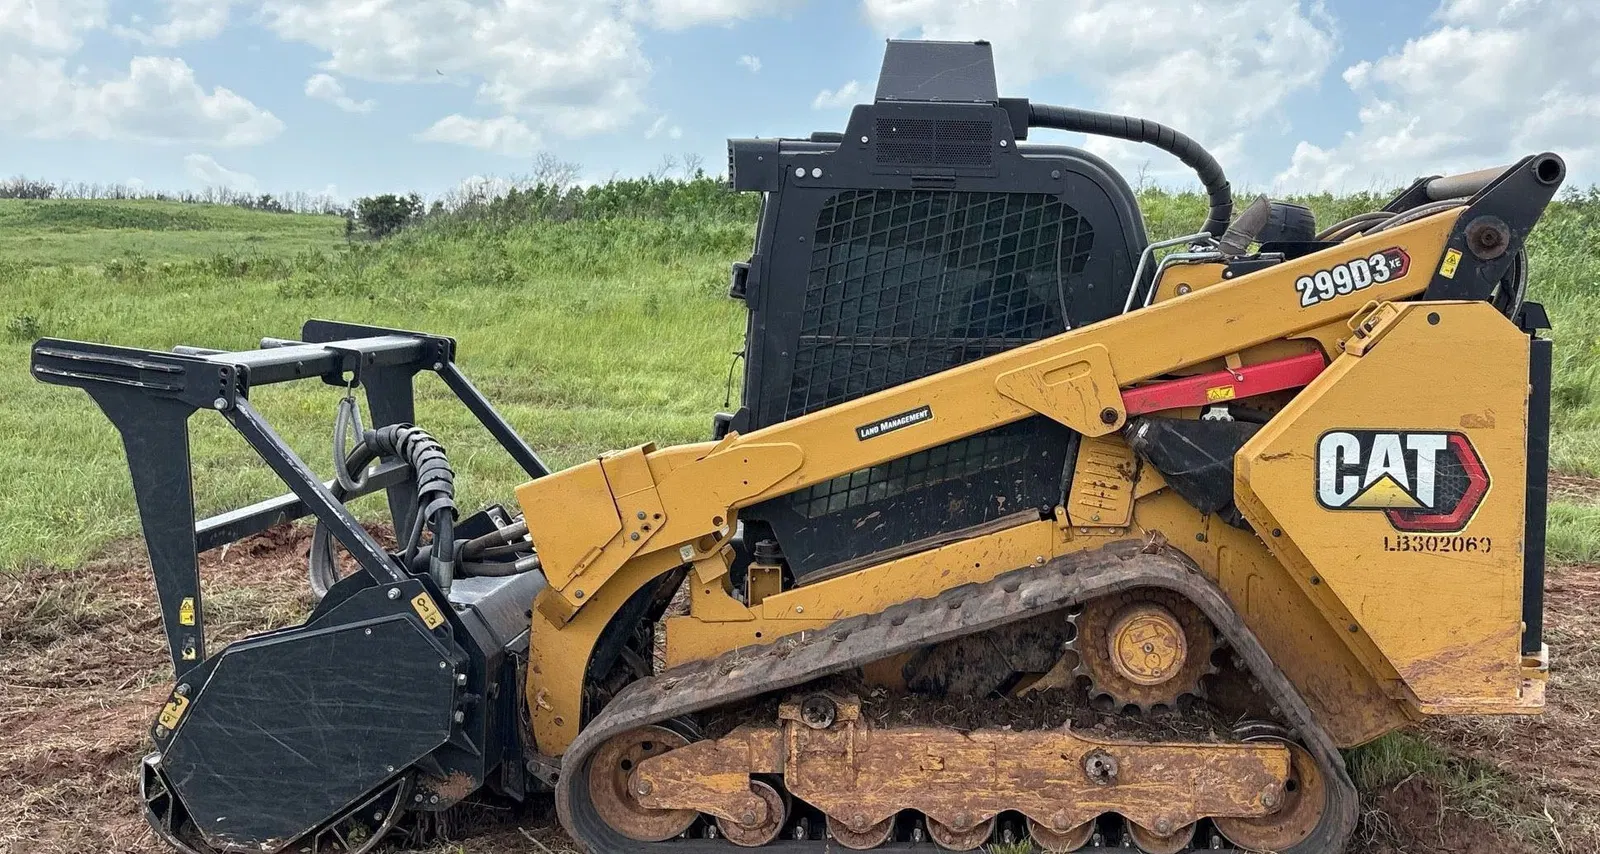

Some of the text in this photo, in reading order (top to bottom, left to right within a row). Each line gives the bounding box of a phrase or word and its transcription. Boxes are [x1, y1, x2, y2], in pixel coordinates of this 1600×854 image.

[1296, 253, 1402, 306] 299D3 XE
[1319, 432, 1447, 508] CAT
